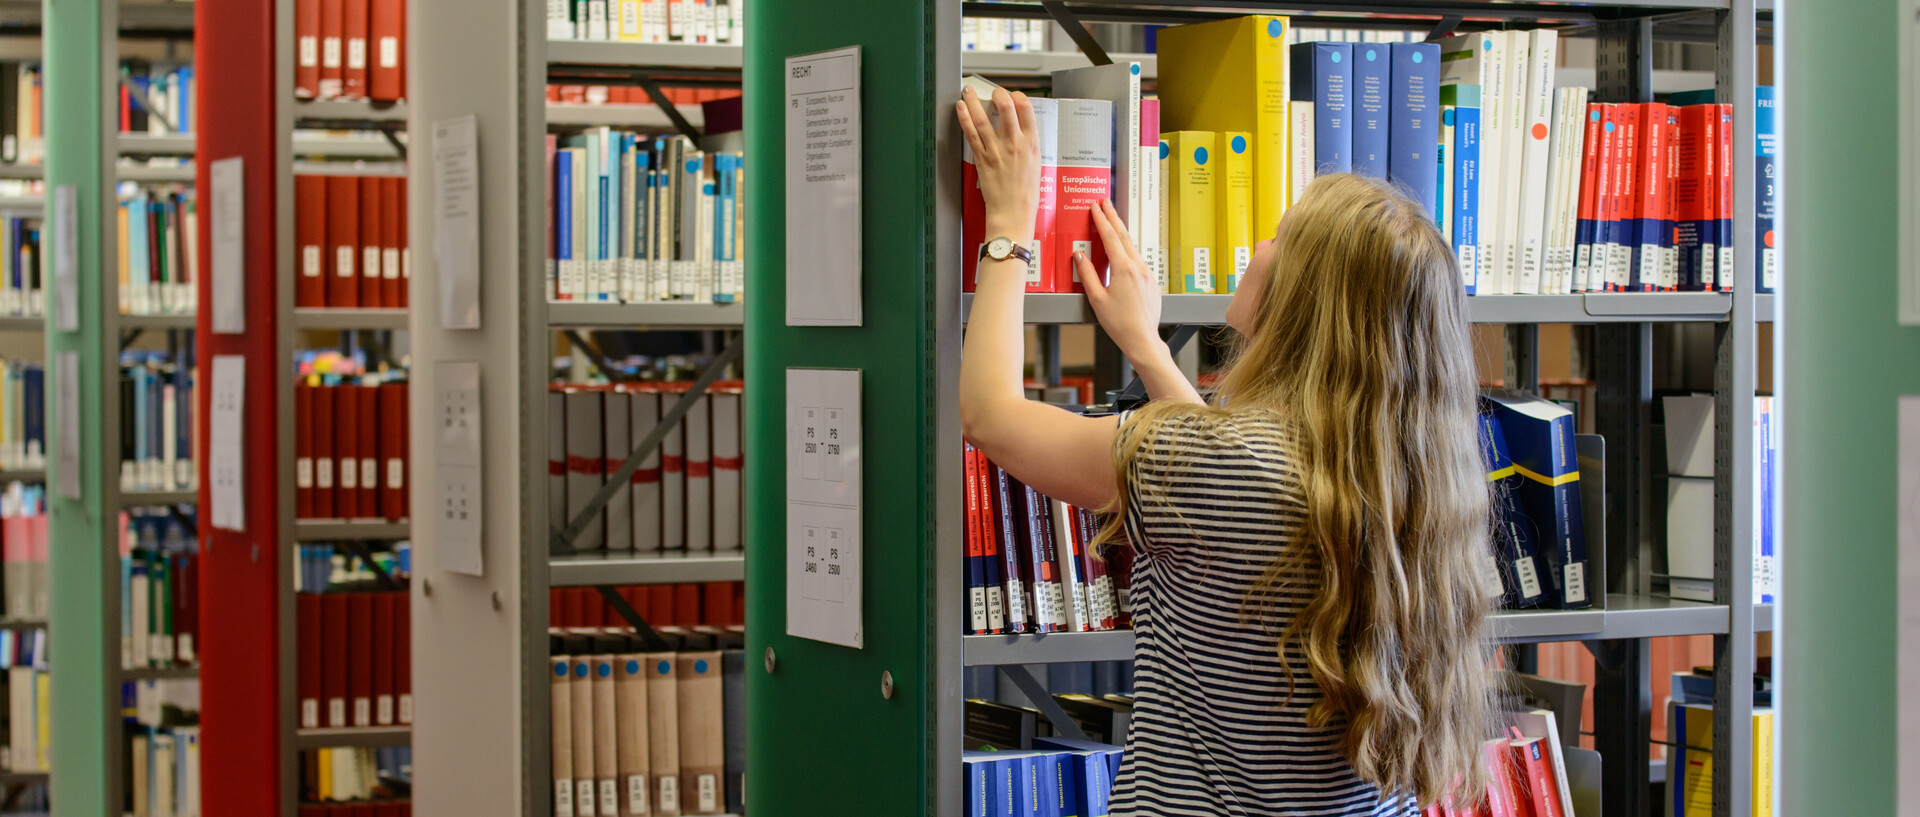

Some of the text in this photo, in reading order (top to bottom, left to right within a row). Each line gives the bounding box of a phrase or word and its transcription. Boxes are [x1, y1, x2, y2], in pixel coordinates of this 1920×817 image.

[792, 66, 812, 79] RECHT
[1301, 150, 1306, 158] in
[1470, 160, 1474, 168] EU
[1062, 175, 1107, 188] Europäisches
[1601, 163, 1609, 196] Europarecht
[1614, 164, 1622, 196] Europarecht
[1650, 162, 1658, 195] Europarecht
[1064, 186, 1106, 194] Unionsrecht
[1767, 184, 1773, 196] 3
[807, 427, 837, 439] PS PS
[805, 443, 840, 455] 2500 2760
[981, 475, 989, 510] Europarecht
[808, 546, 838, 559] PS PS
[806, 562, 840, 575] 2460 2500
[1539, 778, 1548, 796] Union
